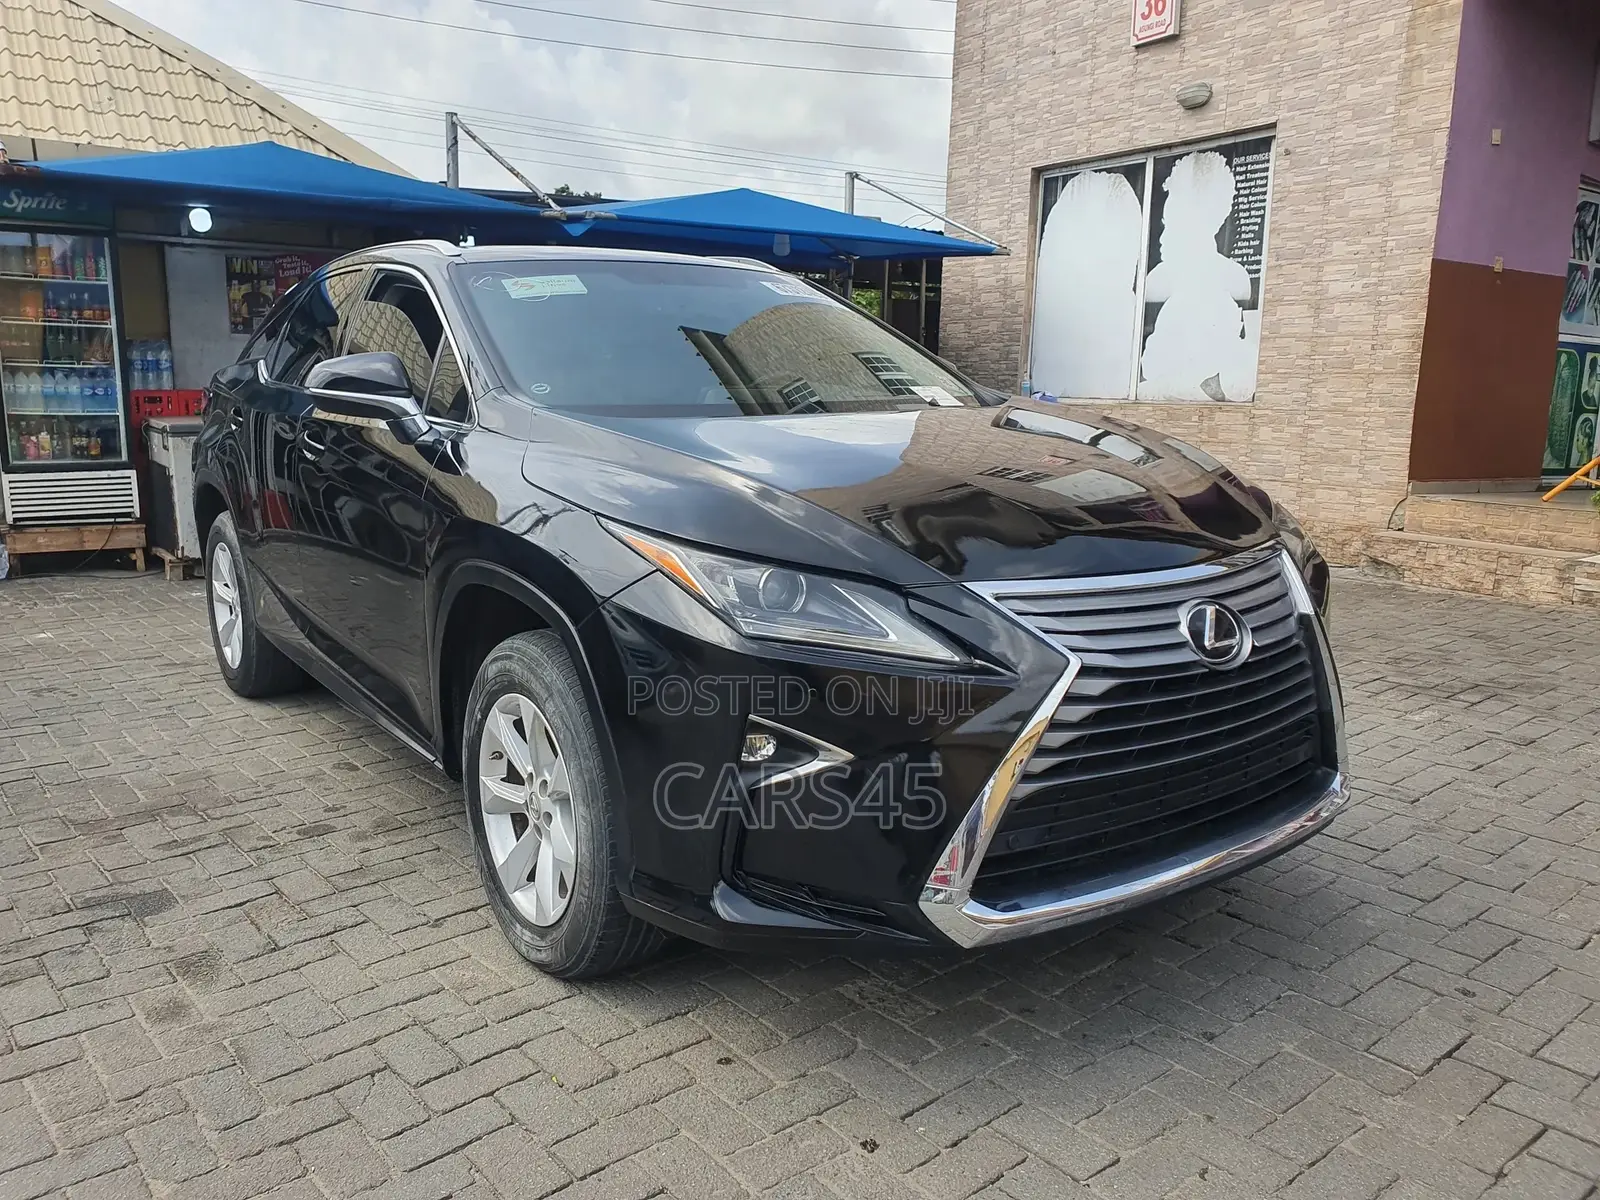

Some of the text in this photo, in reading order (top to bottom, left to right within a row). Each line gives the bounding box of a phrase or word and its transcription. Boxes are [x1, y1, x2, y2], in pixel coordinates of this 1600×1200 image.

[1233, 156, 1245, 164] OUR
[1236, 180, 1256, 188] Natural
[2, 188, 68, 213] Sprite
[1240, 217, 1261, 225] Braiding
[231, 258, 258, 274] WIN
[279, 267, 300, 277] Loud
